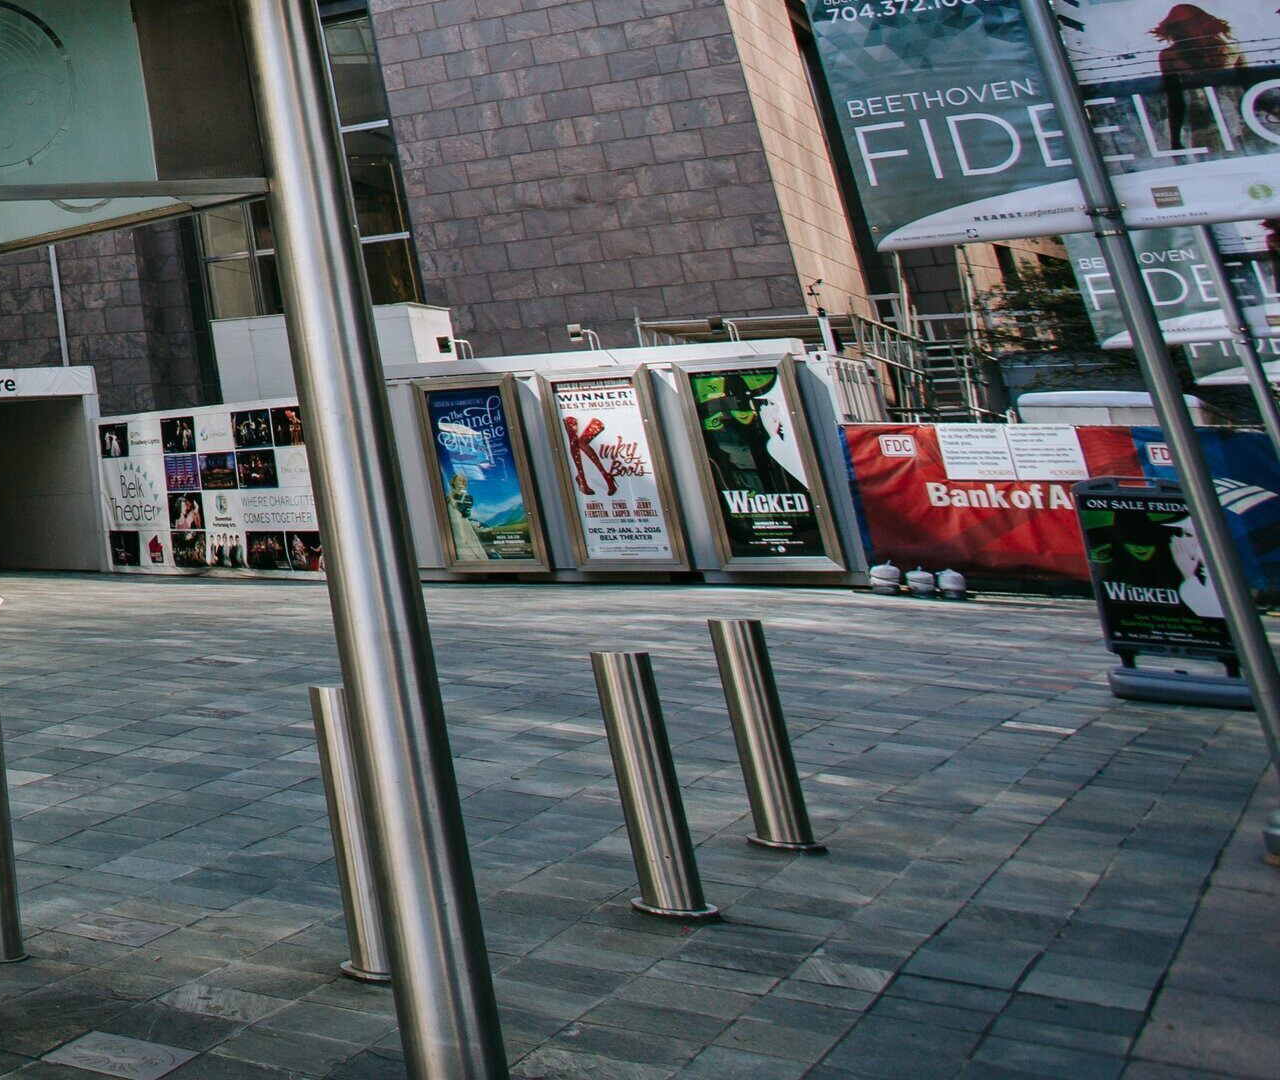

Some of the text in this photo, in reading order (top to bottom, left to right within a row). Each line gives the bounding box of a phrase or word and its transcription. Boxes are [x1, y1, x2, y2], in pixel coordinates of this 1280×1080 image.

[846, 77, 1035, 119] BEETHOVEN
[974, 211, 1023, 222] HEARST
[557, 390, 633, 402] WINNER!
[559, 402, 585, 410] BEST
[588, 400, 636, 408] MUSICAL
[449, 410, 463, 420] The
[493, 409, 501, 421] of
[885, 439, 912, 452] FDC
[1150, 447, 1170, 461] FD
[609, 459, 652, 477] Boots
[120, 474, 145, 499] Belk
[926, 481, 1011, 508] Bank
[1010, 483, 1044, 509] of
[241, 496, 270, 508] WHERE
[1086, 499, 1190, 512] ON SALE FRIDA
[110, 497, 156, 521] Theater
[243, 511, 313, 524] COMES TOGETHER
